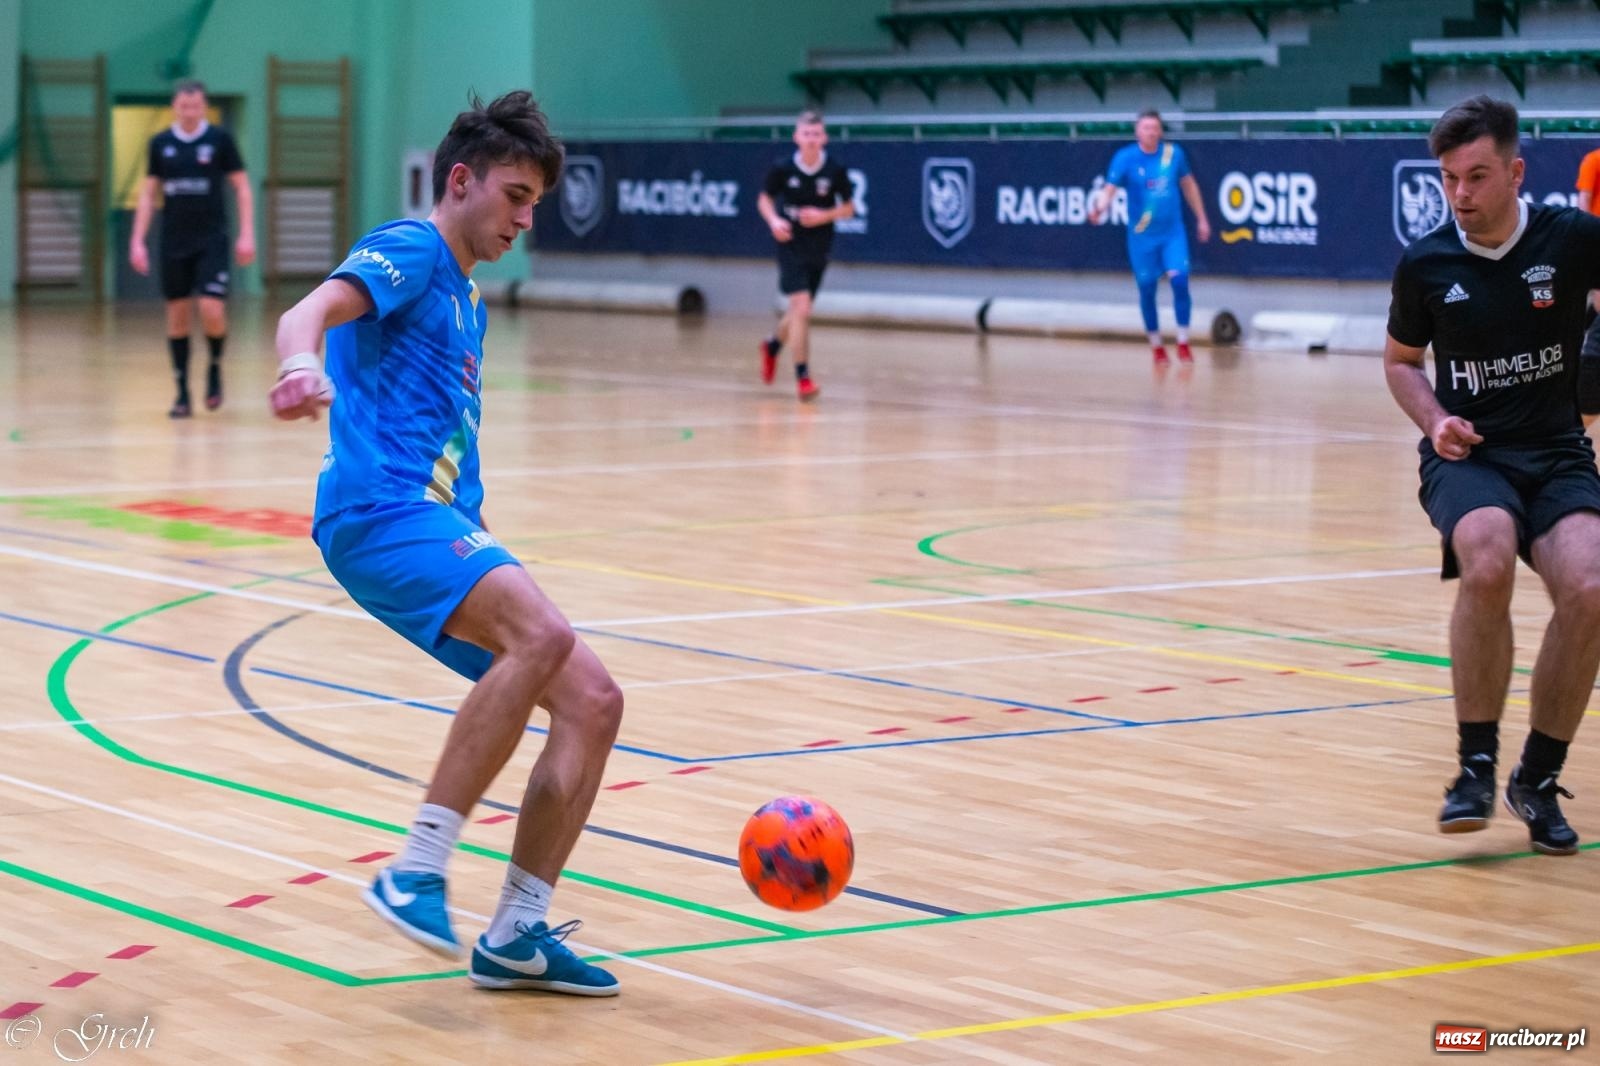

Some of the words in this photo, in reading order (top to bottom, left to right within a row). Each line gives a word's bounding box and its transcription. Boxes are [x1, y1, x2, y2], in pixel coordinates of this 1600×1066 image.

[617, 171, 739, 216] RACIBÓRZ
[997, 175, 1129, 225] RACIBÓR
[1444, 293, 1470, 304] adidas
[1532, 289, 1553, 300] KS
[1487, 375, 1519, 389] PRACA
[1521, 373, 1535, 383] W
